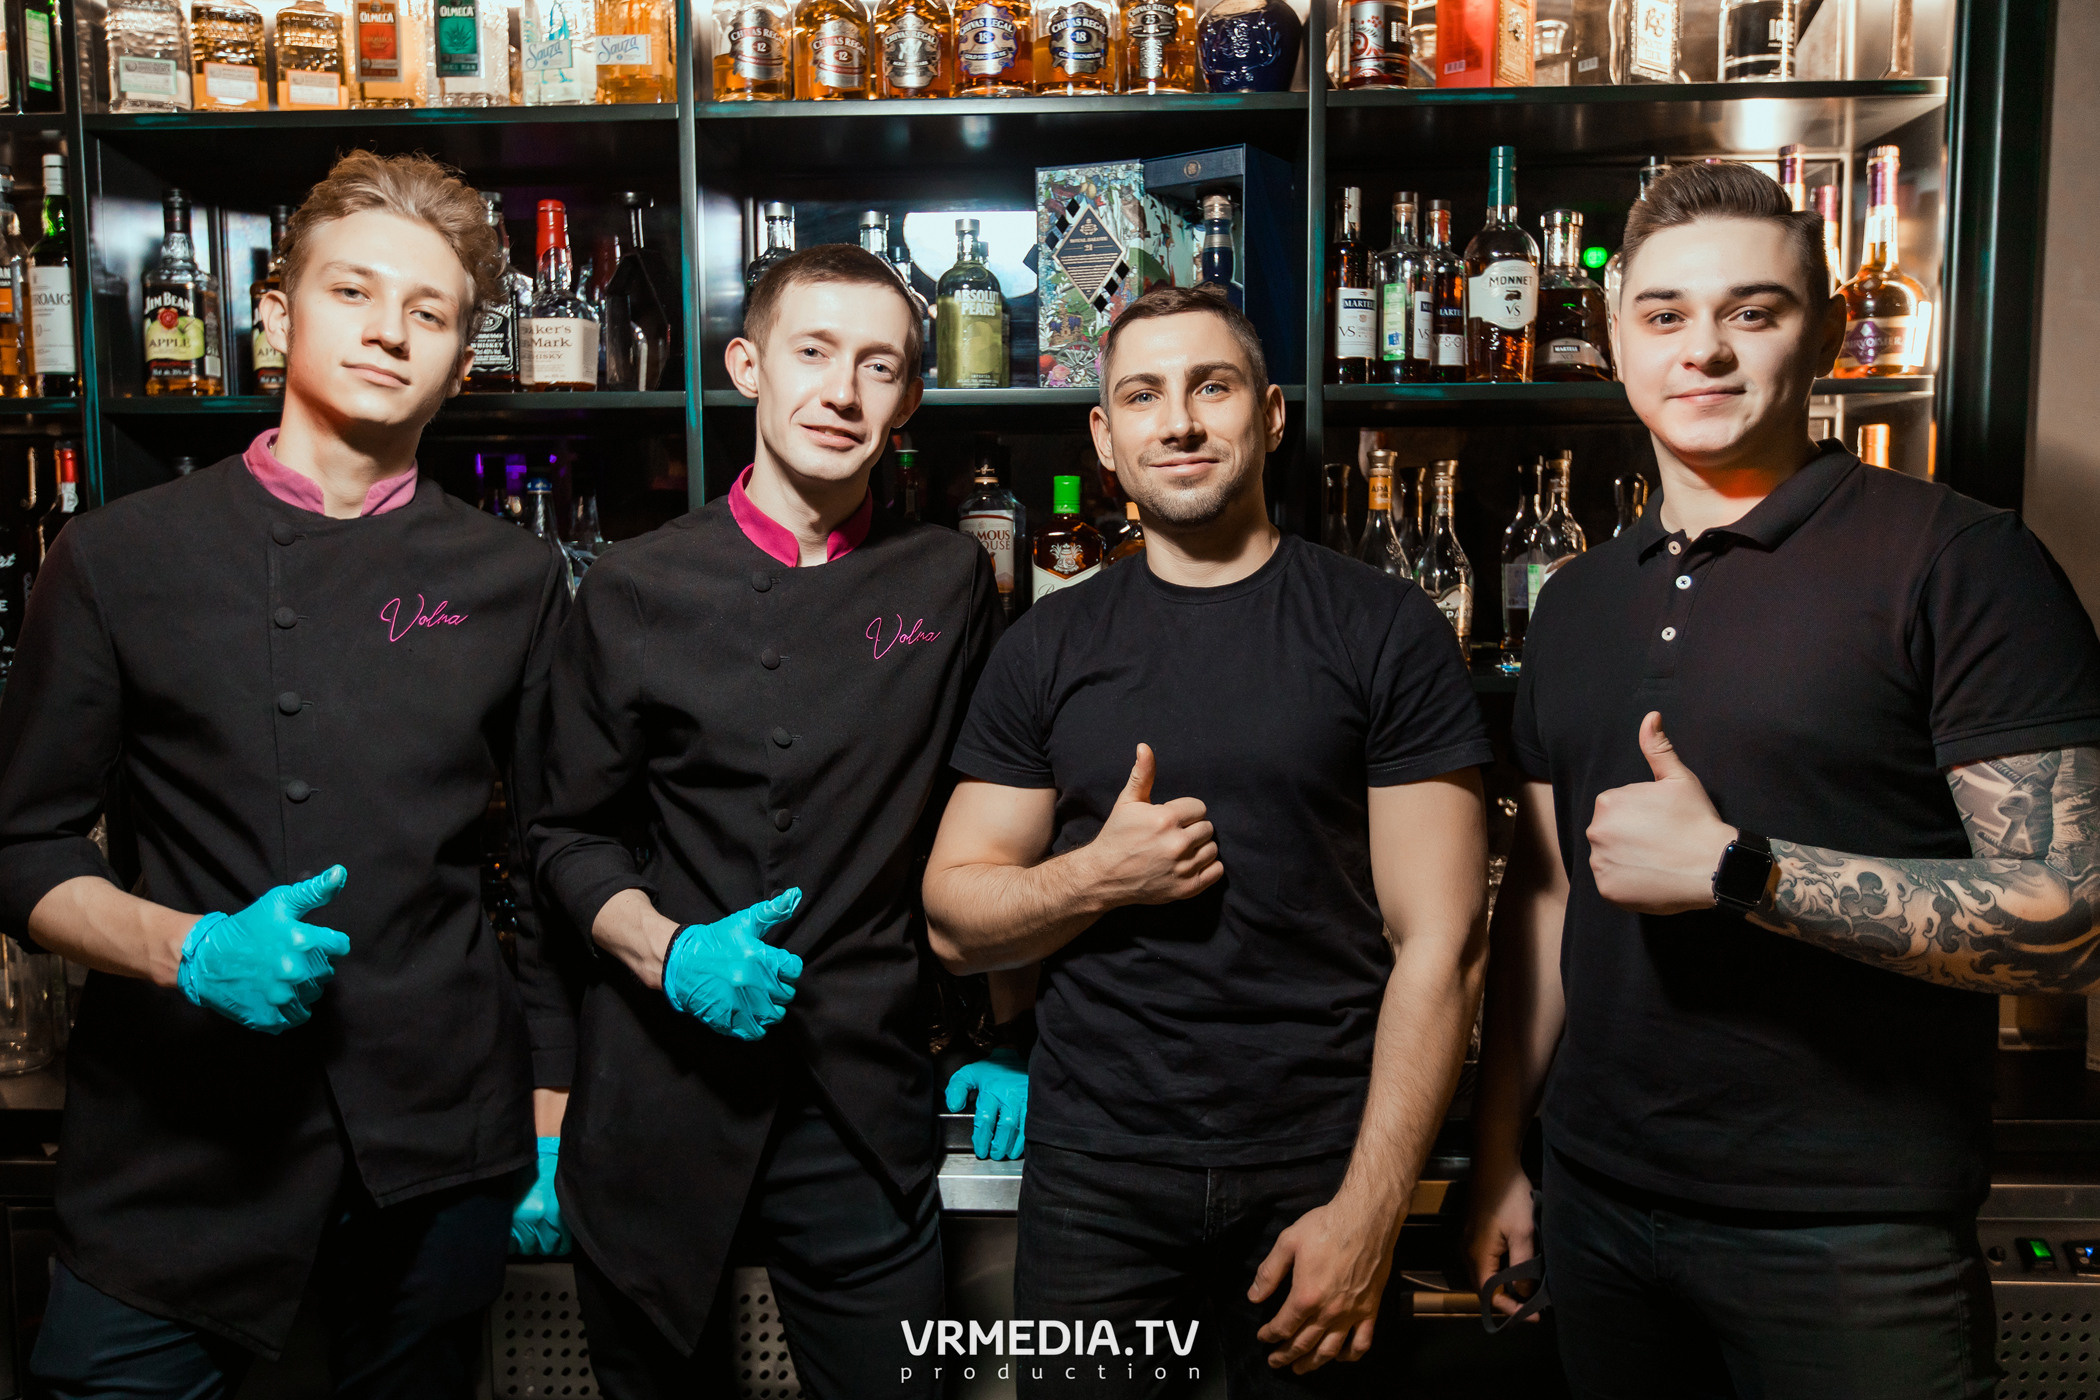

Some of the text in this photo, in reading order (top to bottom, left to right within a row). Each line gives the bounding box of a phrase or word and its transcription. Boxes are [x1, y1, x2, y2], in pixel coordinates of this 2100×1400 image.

[359, 12, 394, 23] OLMECA
[441, 6, 475, 17] OLMECA
[988, 18, 1013, 33] EGAL
[1051, 18, 1107, 34] CHIAS REGAL
[1075, 31, 1087, 42] 18
[598, 36, 640, 63] Sauza
[757, 42, 767, 52] 12
[525, 42, 563, 70] Sauza
[839, 51, 849, 61] 12
[1489, 275, 1533, 287] MONNET
[144, 291, 195, 316] JIM BEAM
[954, 289, 999, 305] ABSOLUT
[961, 302, 996, 317] PEARS
[1506, 303, 1521, 317] VS
[150, 338, 191, 348] APPLE
[380, 593, 469, 643] Volna
[865, 612, 942, 660] Volna
